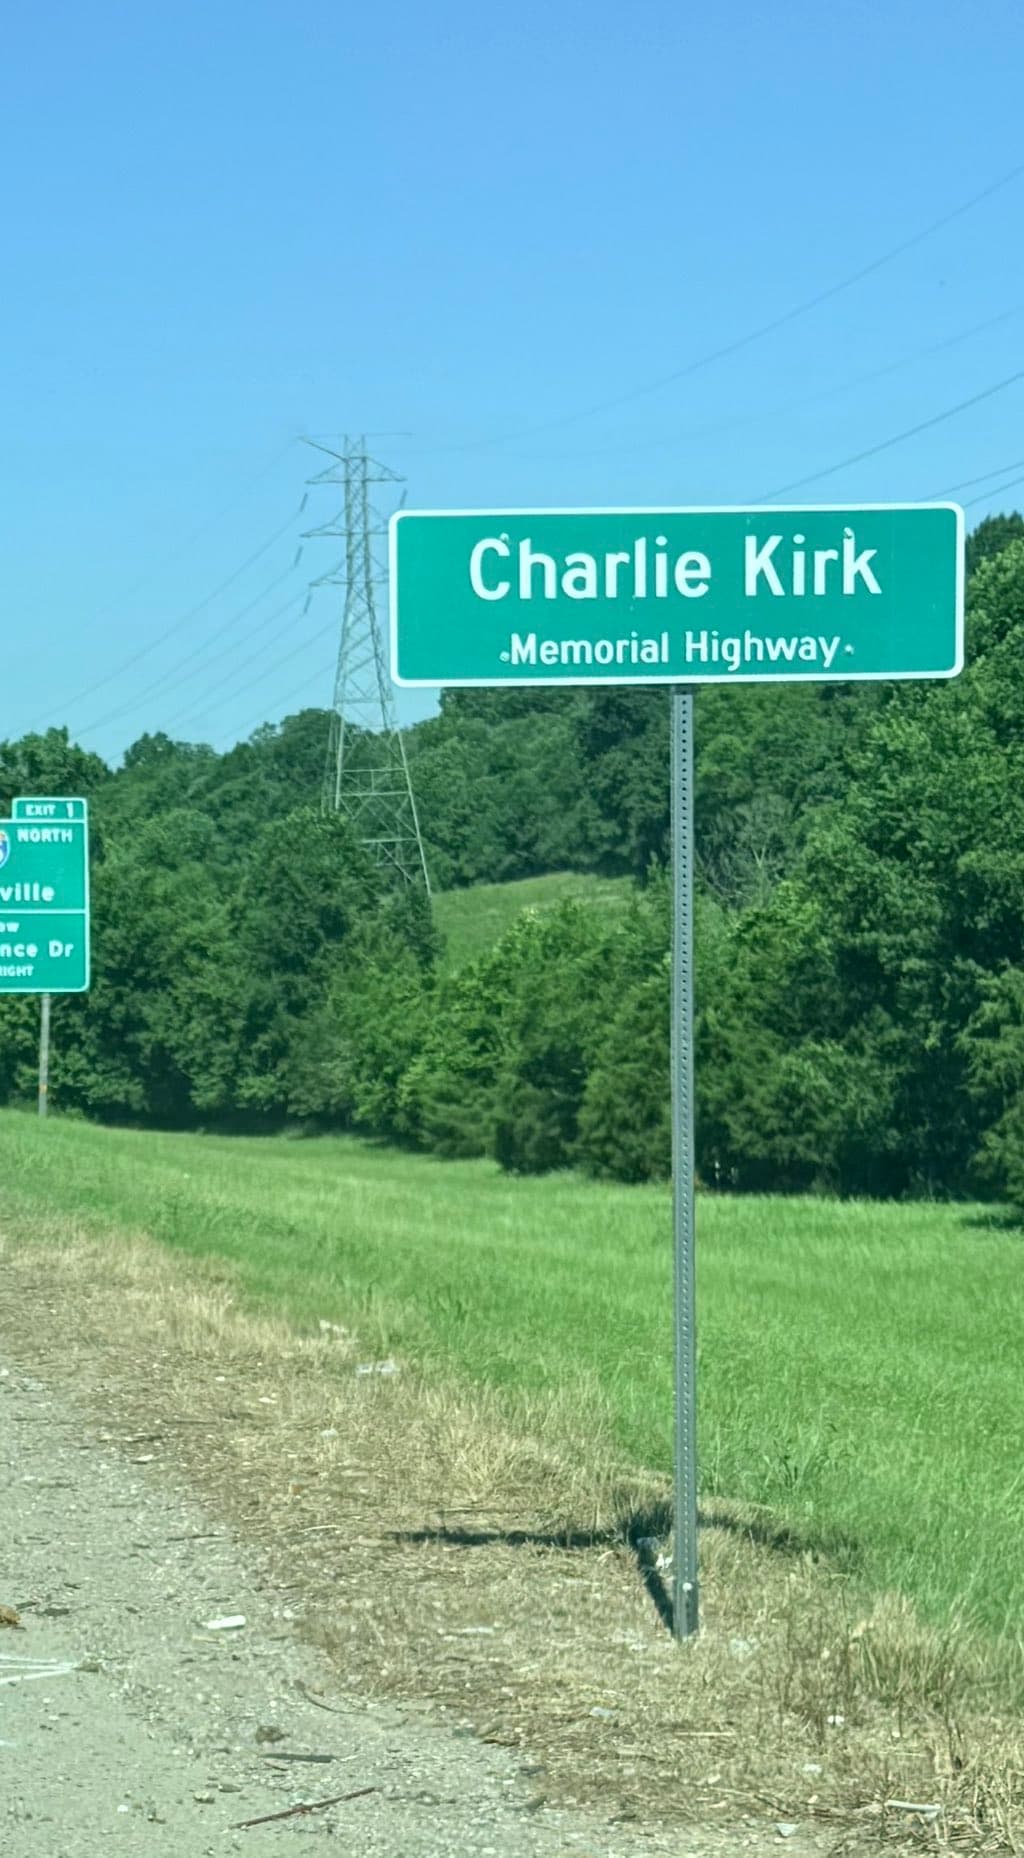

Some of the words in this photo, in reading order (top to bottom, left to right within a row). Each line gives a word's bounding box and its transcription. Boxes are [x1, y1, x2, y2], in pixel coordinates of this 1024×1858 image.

[469, 535, 712, 600] Charlie
[744, 530, 882, 598] Kirk
[510, 631, 669, 665] Memorial
[685, 629, 841, 671] Highway
[25, 804, 56, 817] EXIT
[66, 802, 74, 818] 1
[17, 828, 73, 843] NORTH
[48, 940, 74, 958] Dr
